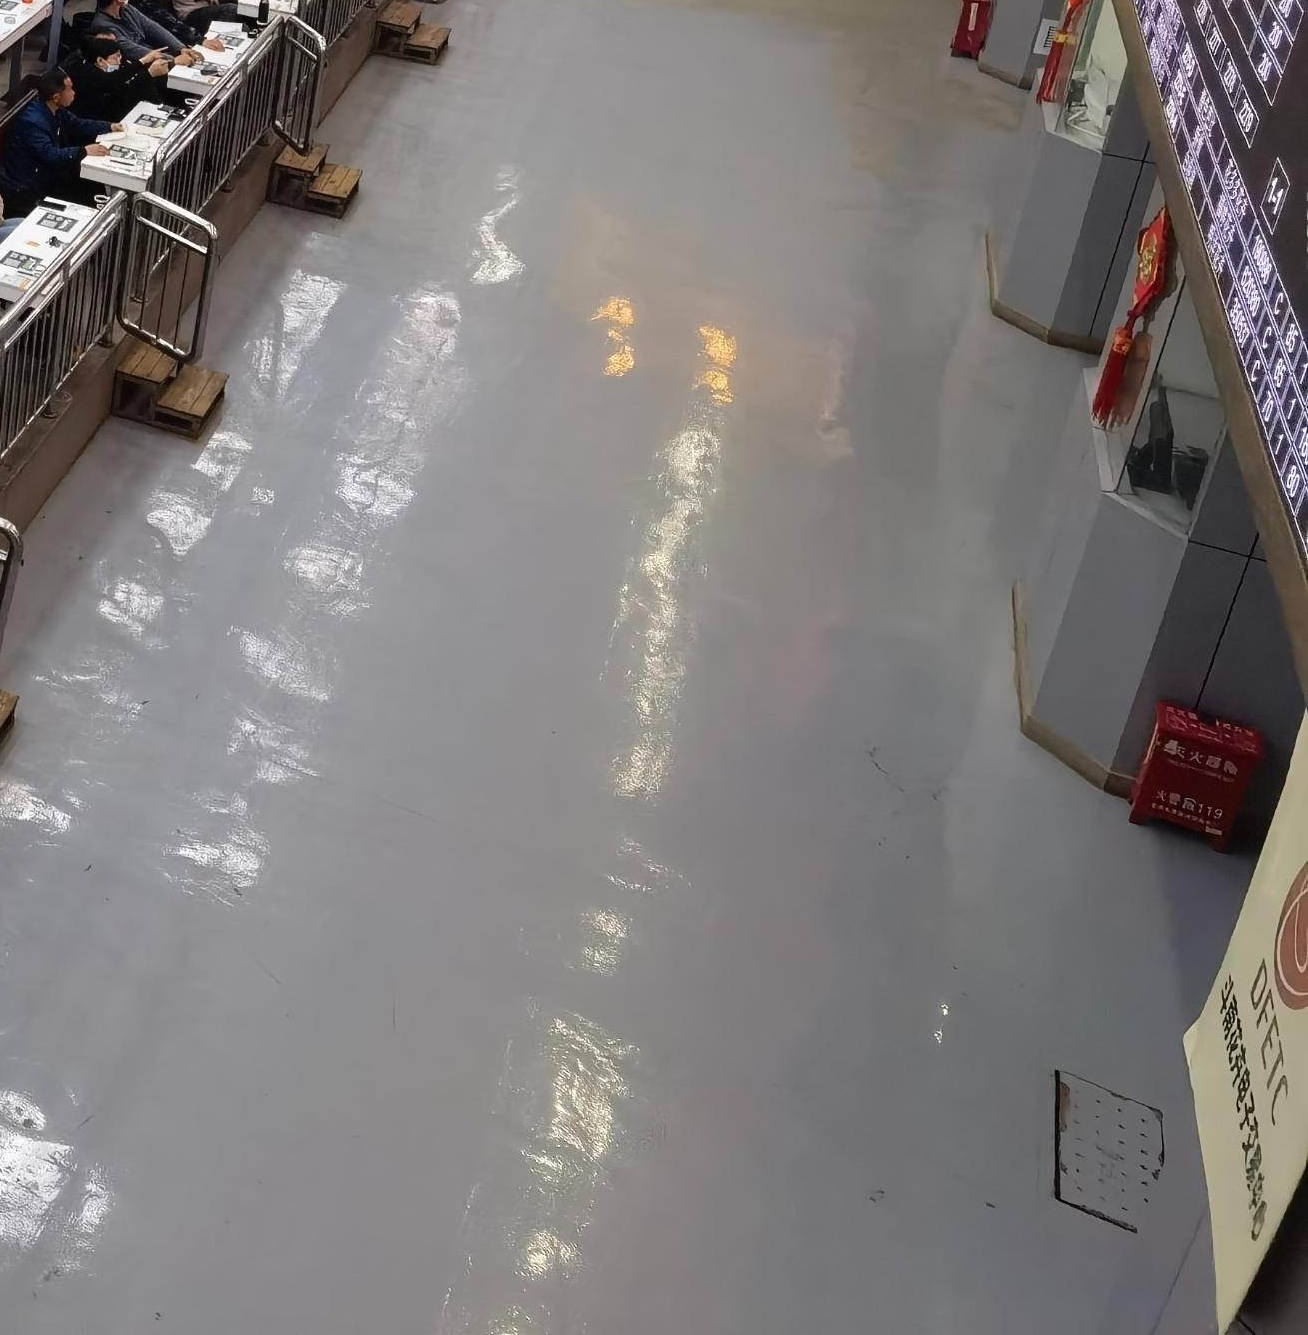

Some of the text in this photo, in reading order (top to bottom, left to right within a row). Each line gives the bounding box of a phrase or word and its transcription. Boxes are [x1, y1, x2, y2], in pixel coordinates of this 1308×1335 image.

[1268, 177, 1284, 215] 1-1
[1275, 292, 1284, 315] C
[1263, 326, 1271, 349] C
[1251, 359, 1261, 382] C
[1264, 390, 1274, 422] 70
[1288, 398, 1296, 420] 1
[1275, 433, 1284, 455] 1
[1198, 803, 1223, 819] 119
[1250, 958, 1288, 1126] DFETC
